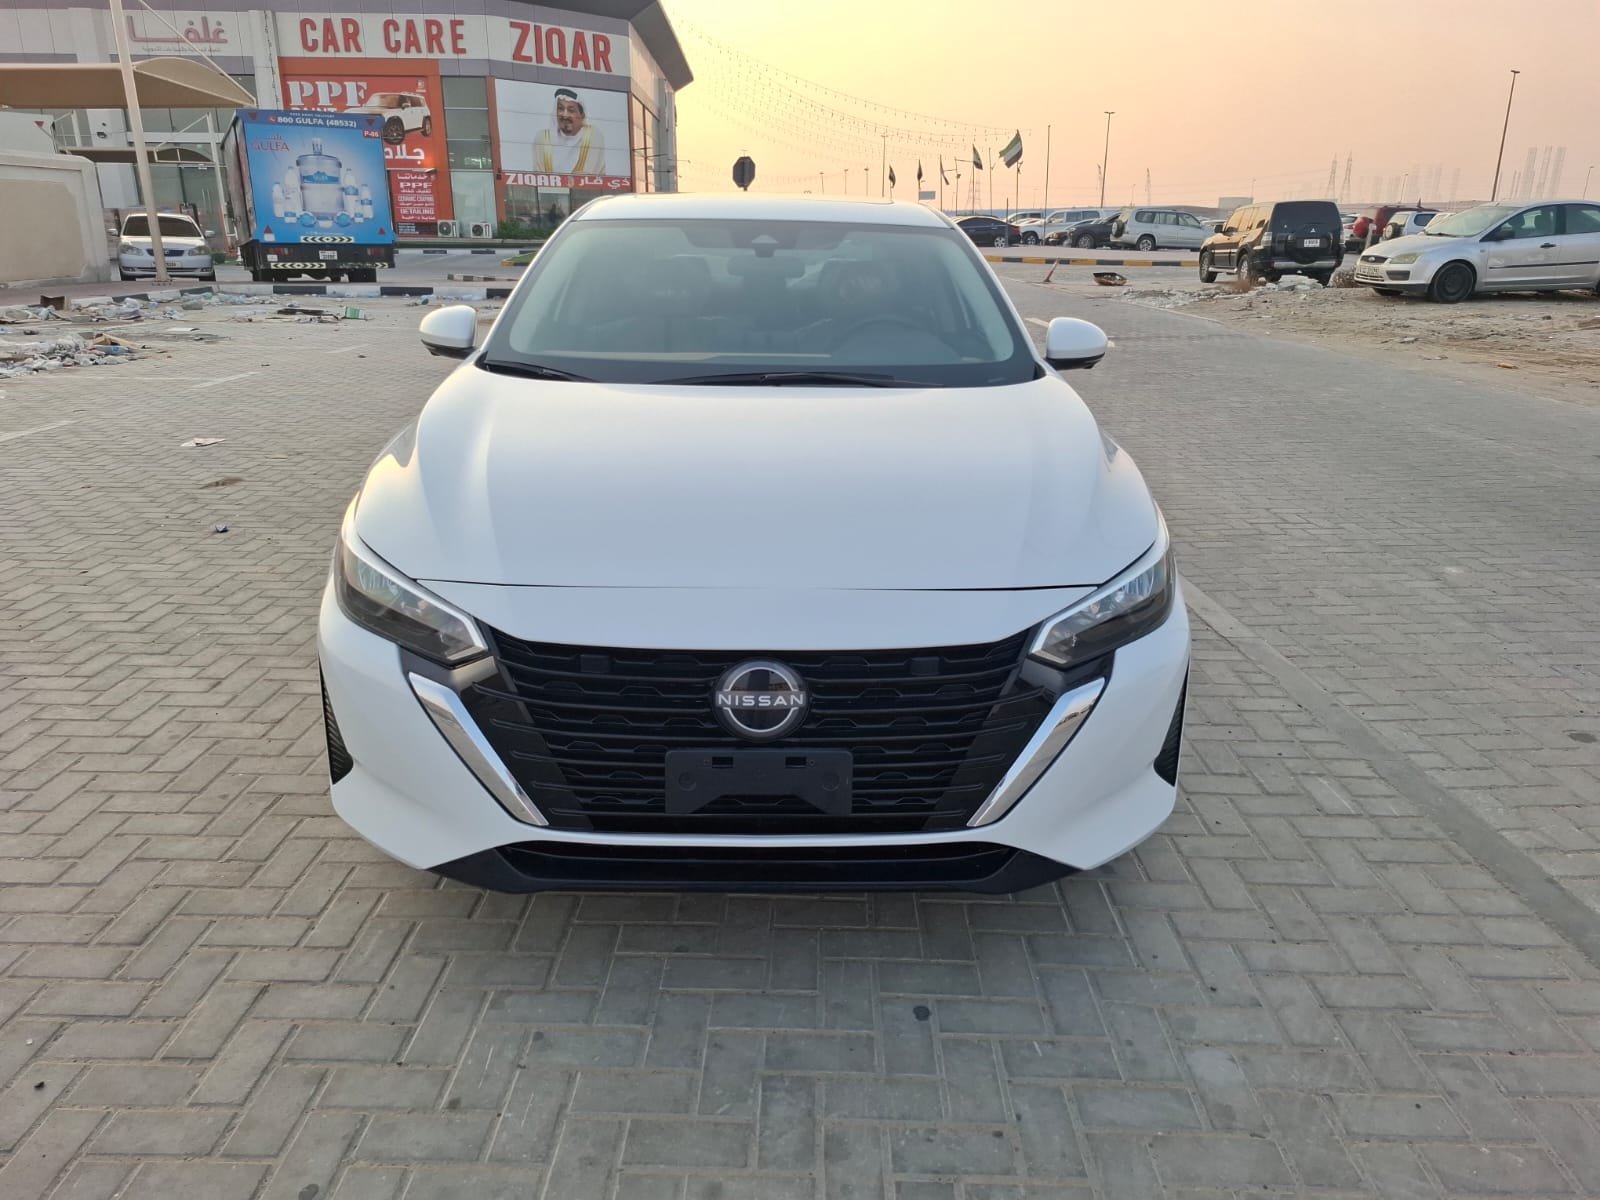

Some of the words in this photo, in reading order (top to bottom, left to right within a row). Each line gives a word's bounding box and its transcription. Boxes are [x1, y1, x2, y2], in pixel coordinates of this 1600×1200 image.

[300, 17, 363, 53] CAR
[383, 18, 467, 55] CARE
[509, 20, 613, 73] ZIQAR
[286, 80, 368, 106] PPF
[277, 116, 294, 124] 800
[295, 118, 324, 126] GULFA
[399, 181, 433, 189] PPF
[505, 173, 562, 187] ZIQAR
[718, 693, 804, 707] NISSAN
